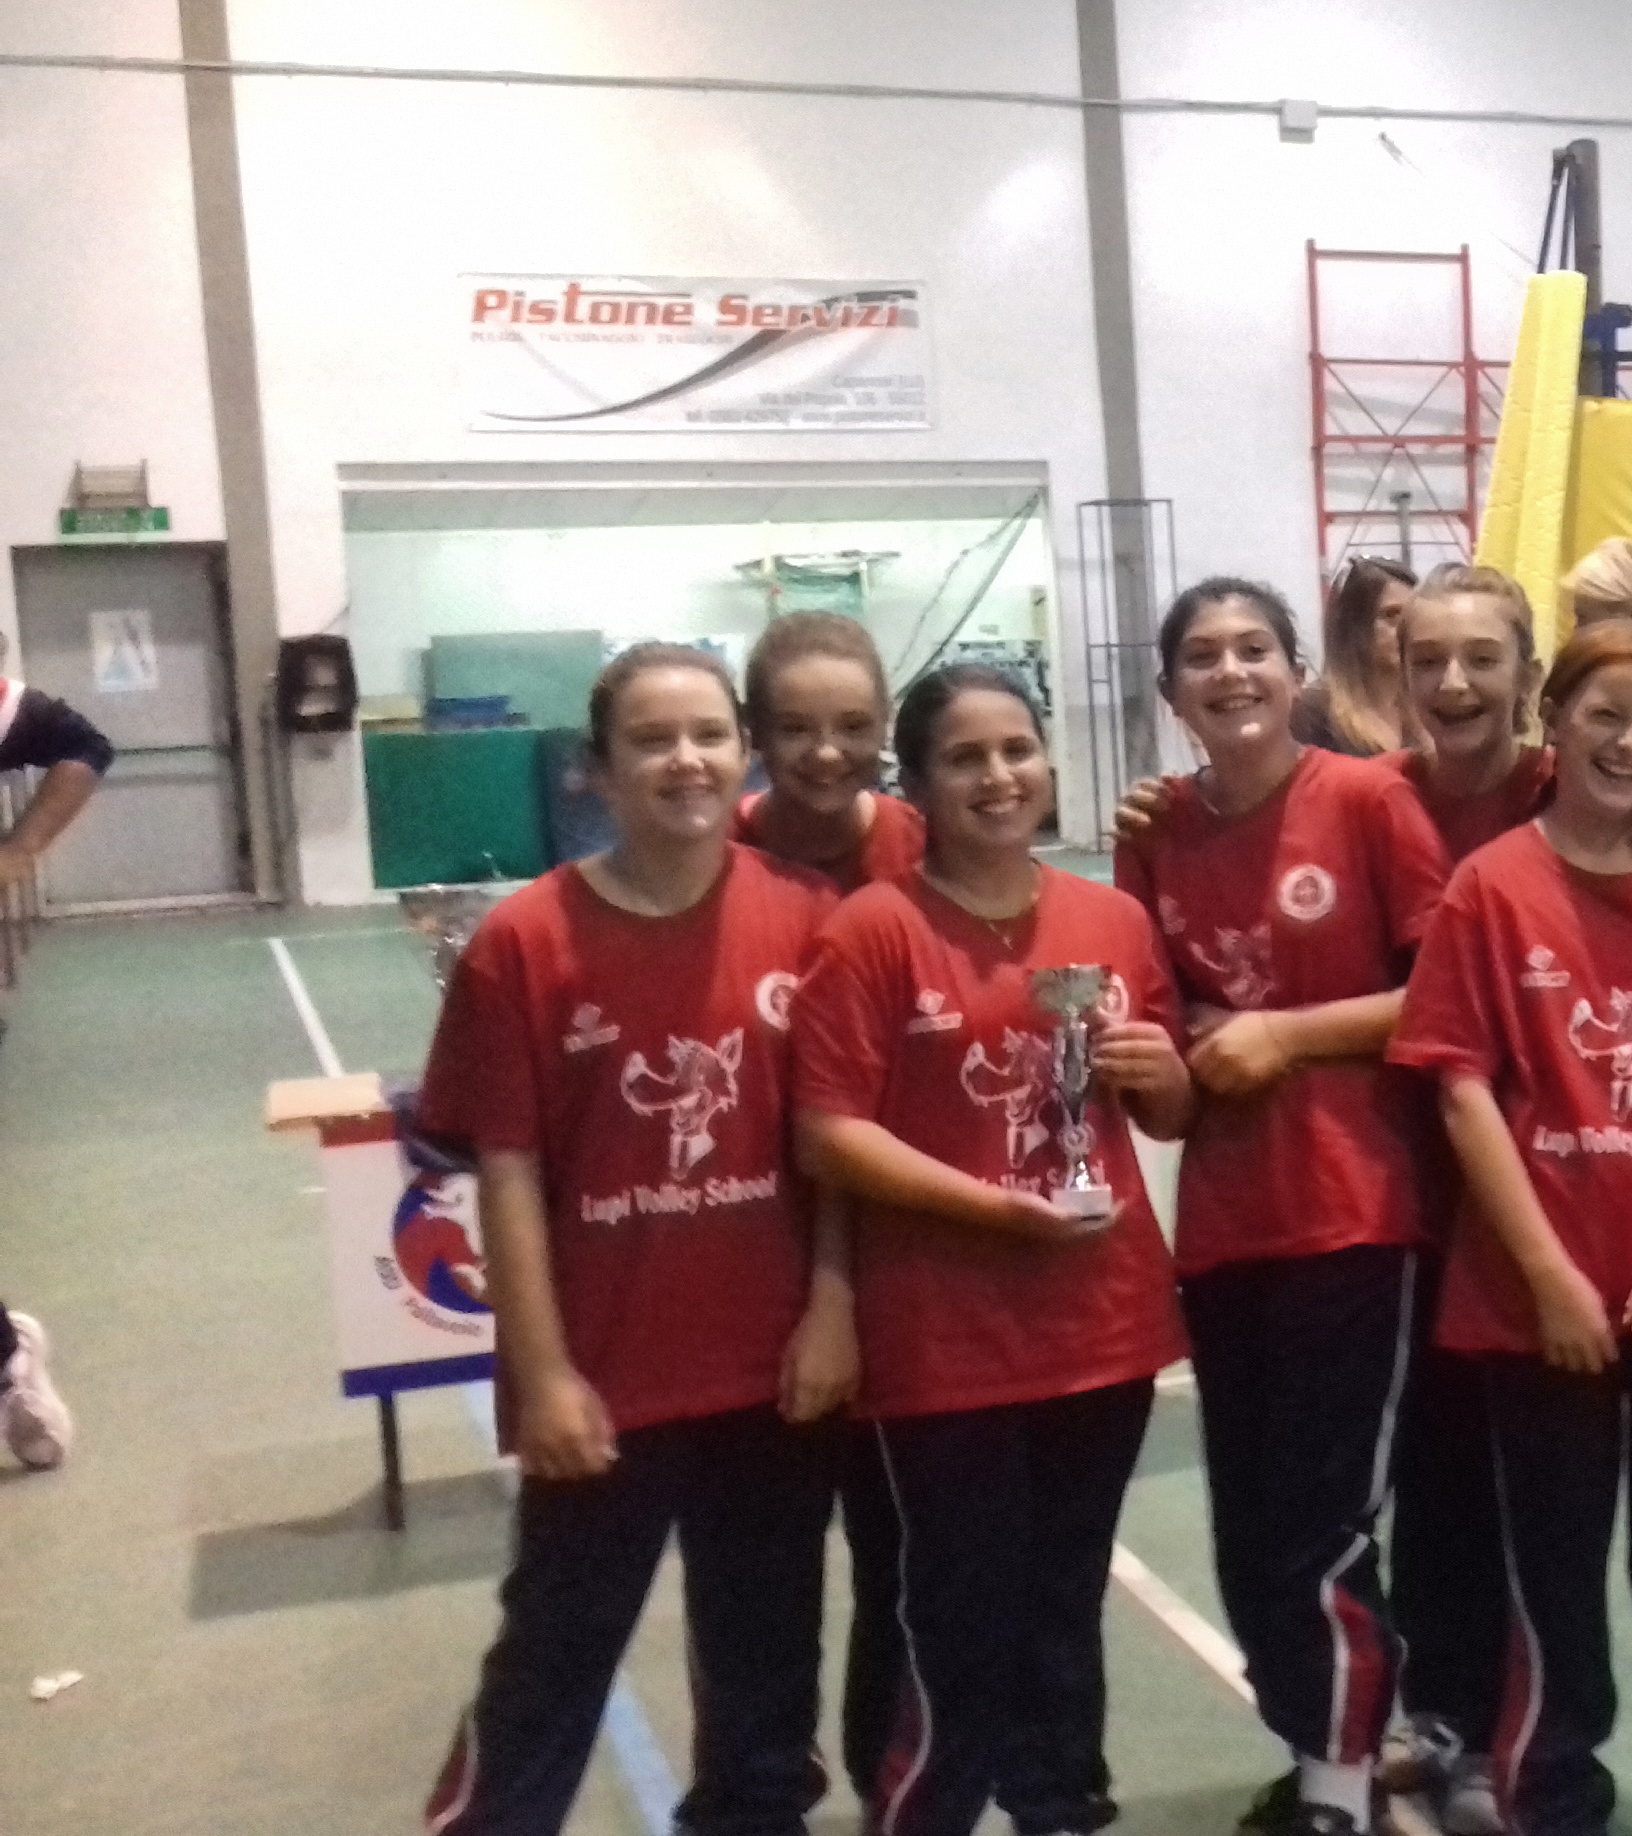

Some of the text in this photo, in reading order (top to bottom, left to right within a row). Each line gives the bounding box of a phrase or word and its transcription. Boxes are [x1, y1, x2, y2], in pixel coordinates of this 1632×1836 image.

[472, 282, 902, 328] Pistone Servizi
[633, 1182, 702, 1216] Volley
[704, 1170, 778, 1207] School
